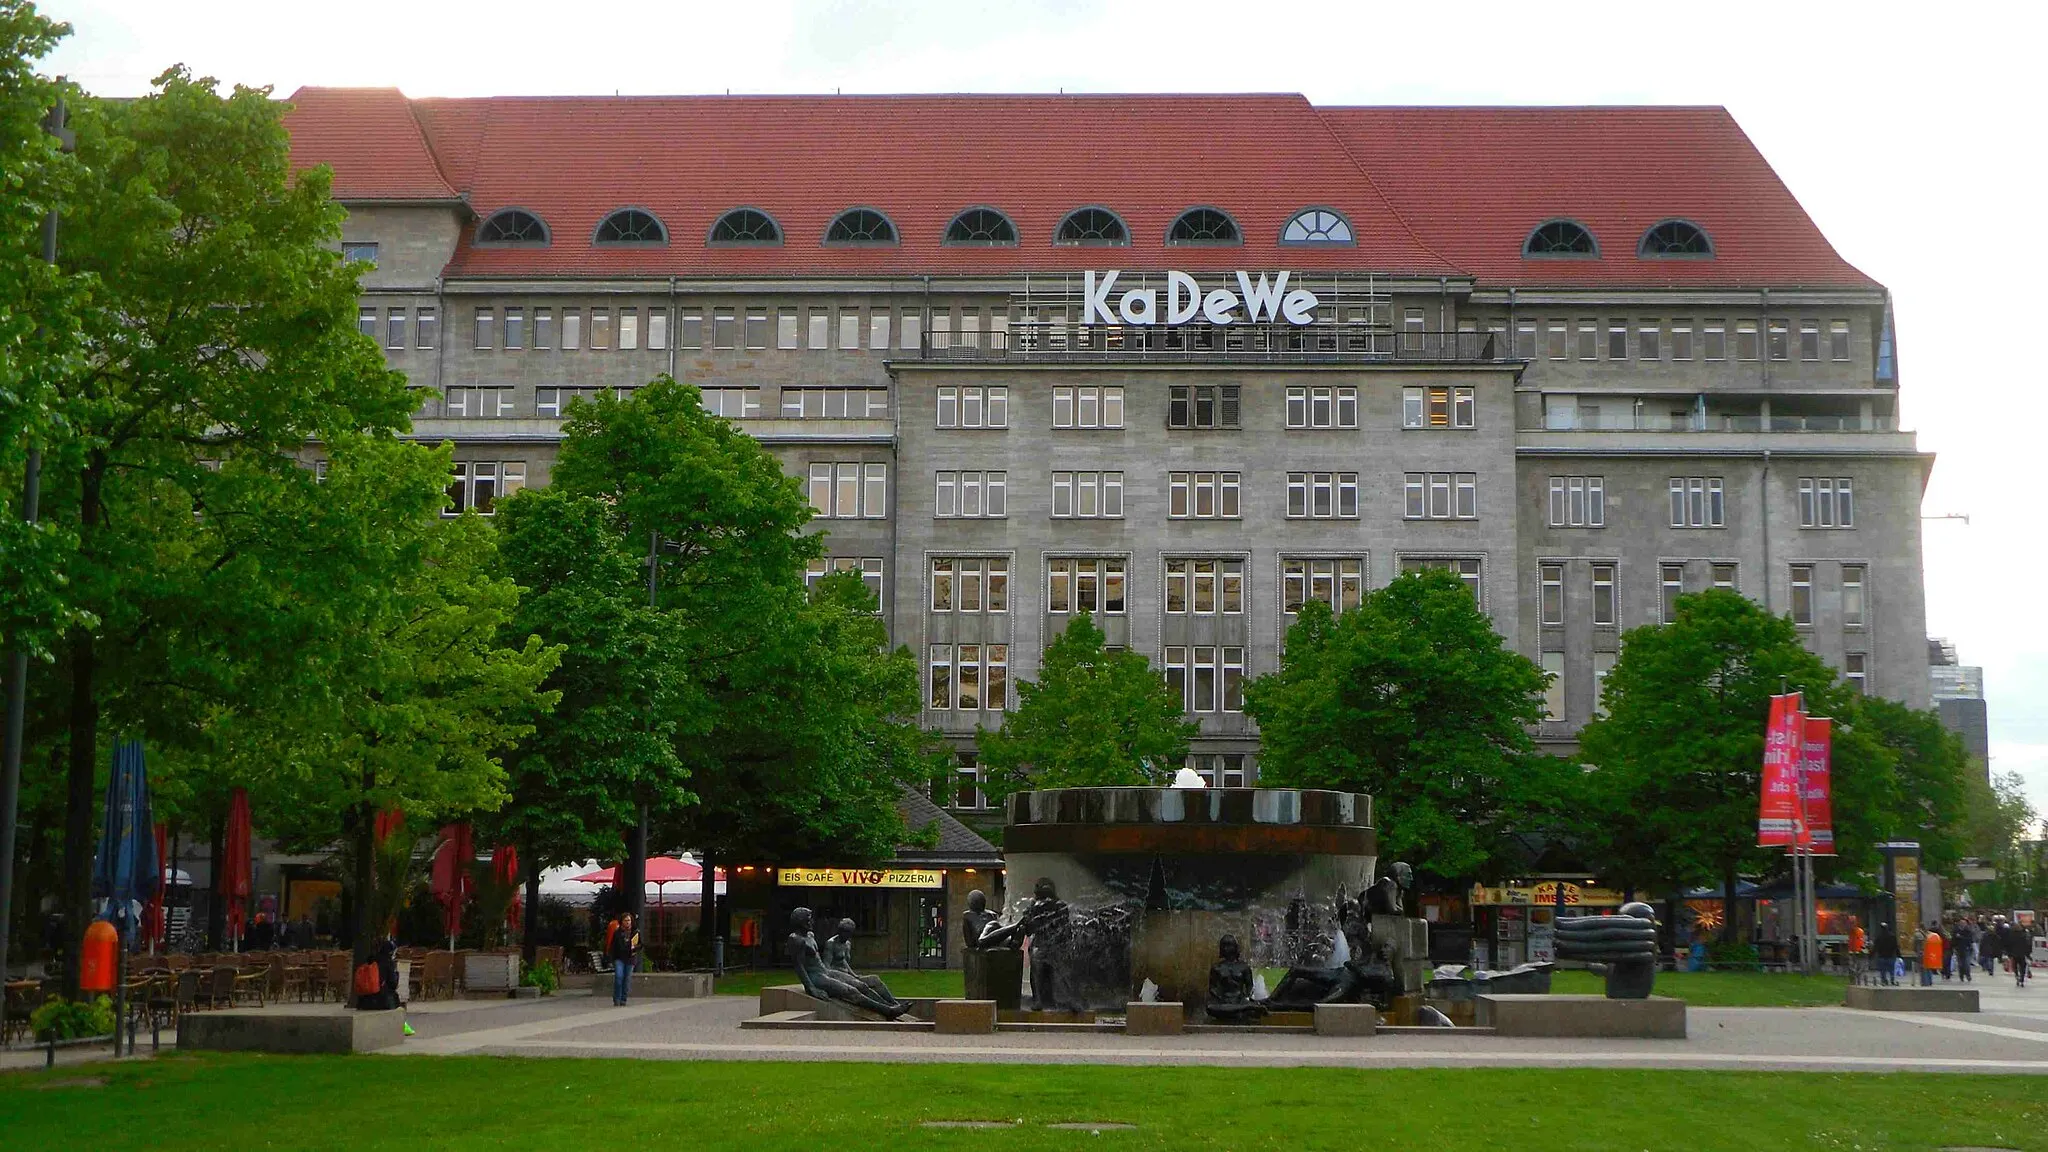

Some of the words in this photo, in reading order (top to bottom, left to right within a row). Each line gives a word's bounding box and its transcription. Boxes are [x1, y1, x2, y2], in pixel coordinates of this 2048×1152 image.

[1084, 270, 1319, 326] KaDeWe
[784, 872, 801, 881] EIS
[842, 870, 885, 884] VIVO
[889, 874, 935, 883] PIZZERIA
[1534, 894, 1579, 903] IMBSS
